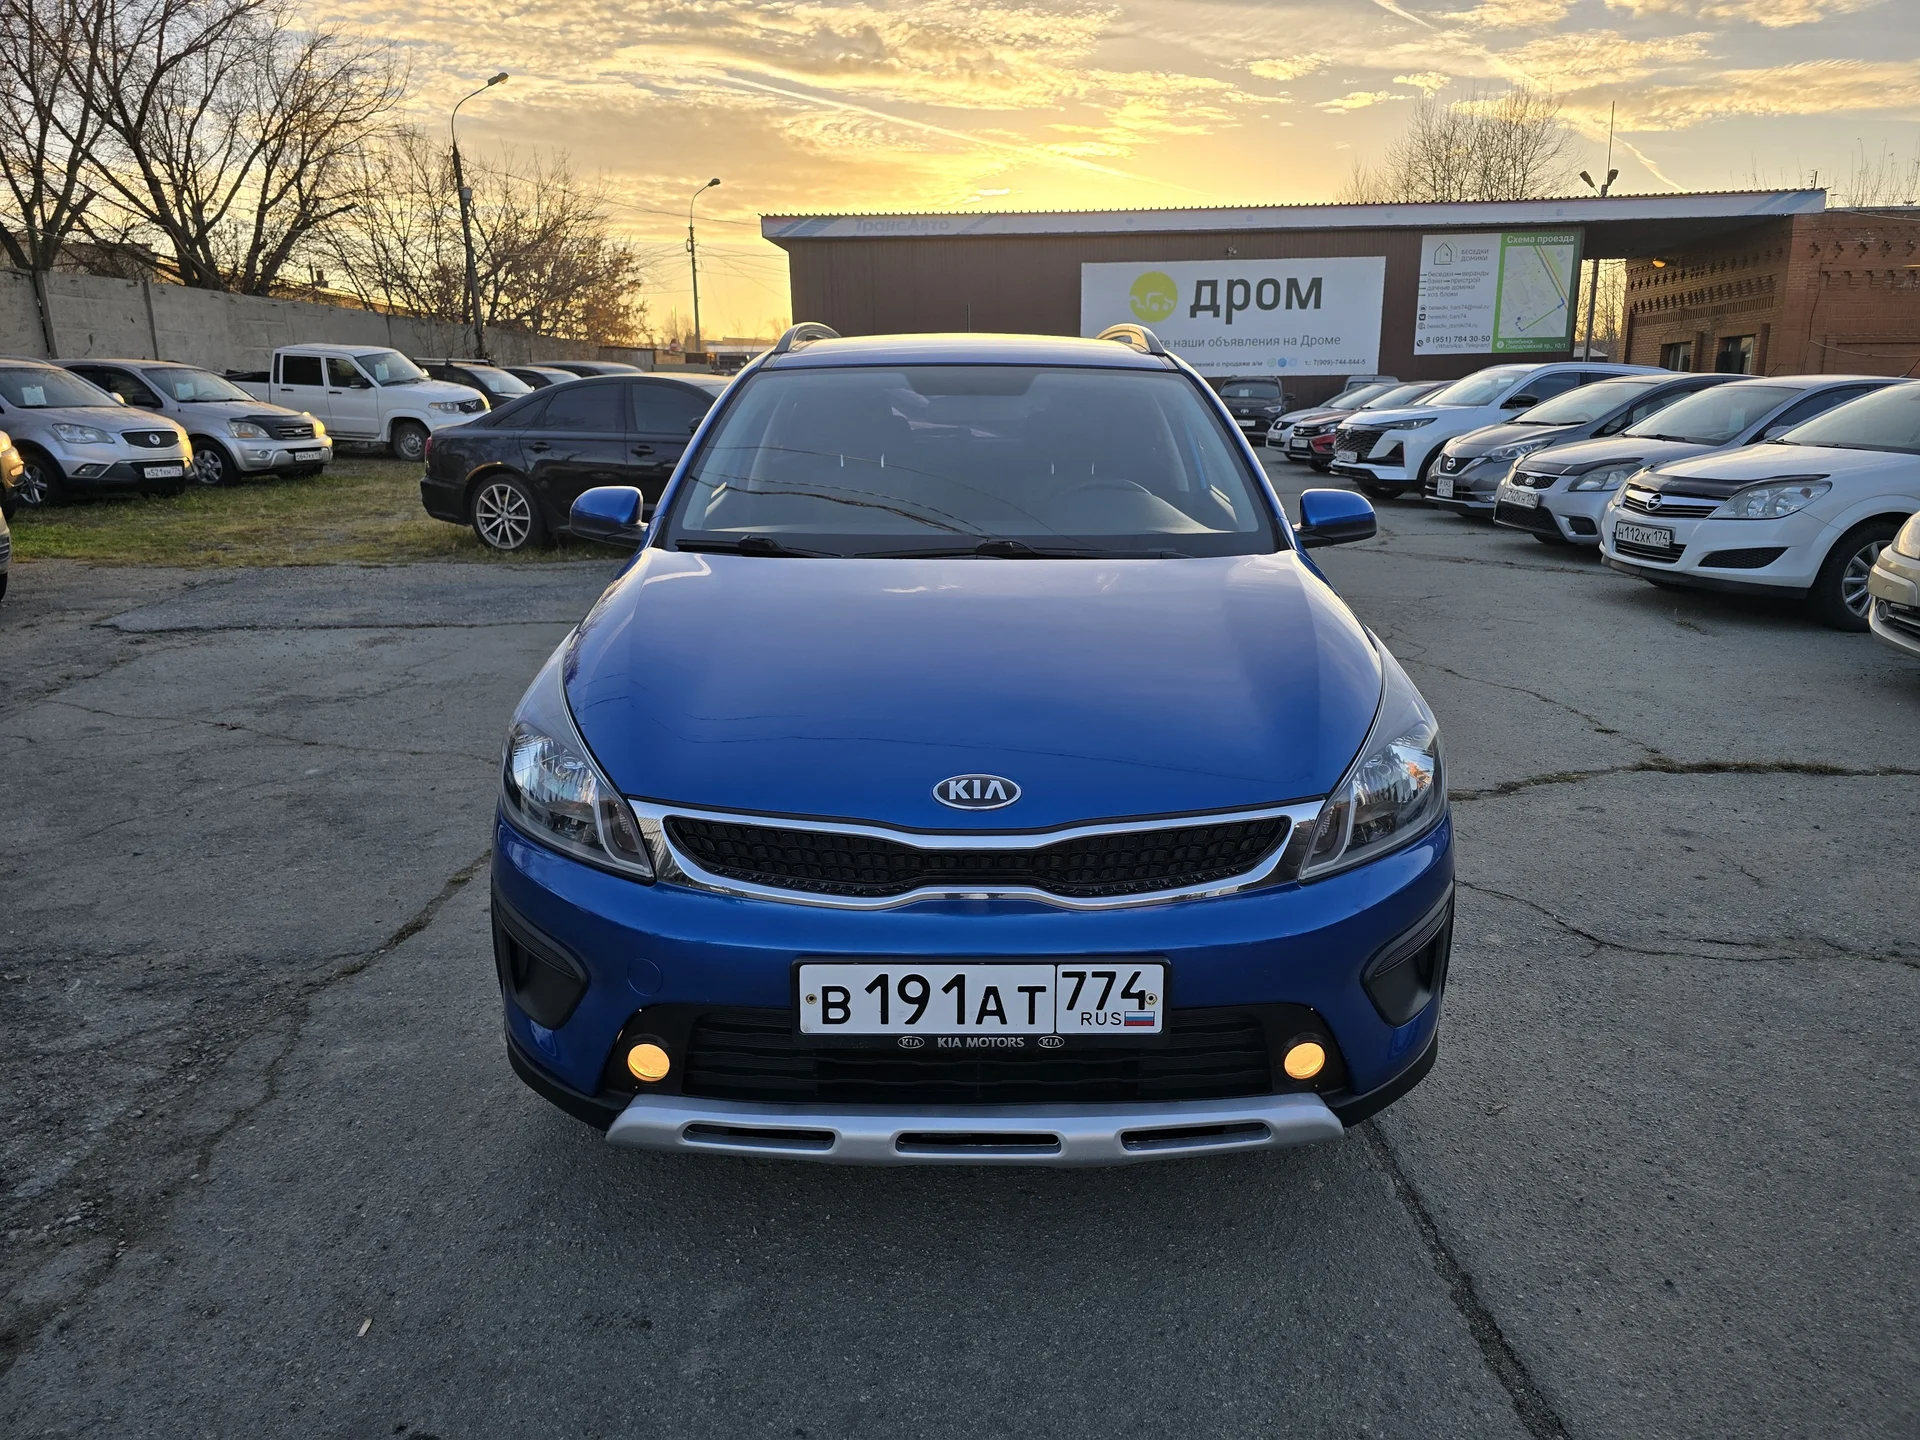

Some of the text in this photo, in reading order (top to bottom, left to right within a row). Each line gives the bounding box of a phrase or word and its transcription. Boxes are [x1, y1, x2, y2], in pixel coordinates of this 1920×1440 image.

[1537, 235, 1574, 244] проезда
[1189, 276, 1323, 325] дром
[1173, 338, 1205, 348] наши
[1208, 336, 1281, 348] объявления
[1283, 337, 1297, 347] на
[1300, 335, 1341, 348] Дроме
[1432, 336, 1451, 344] (951)
[1618, 526, 1668, 543] Н112ХК 174
[948, 779, 1007, 800] KIA
[1061, 971, 1146, 1011] 774
[1081, 1011, 1122, 1026] RUS
[937, 1037, 1025, 1048] KIA MOTORS
